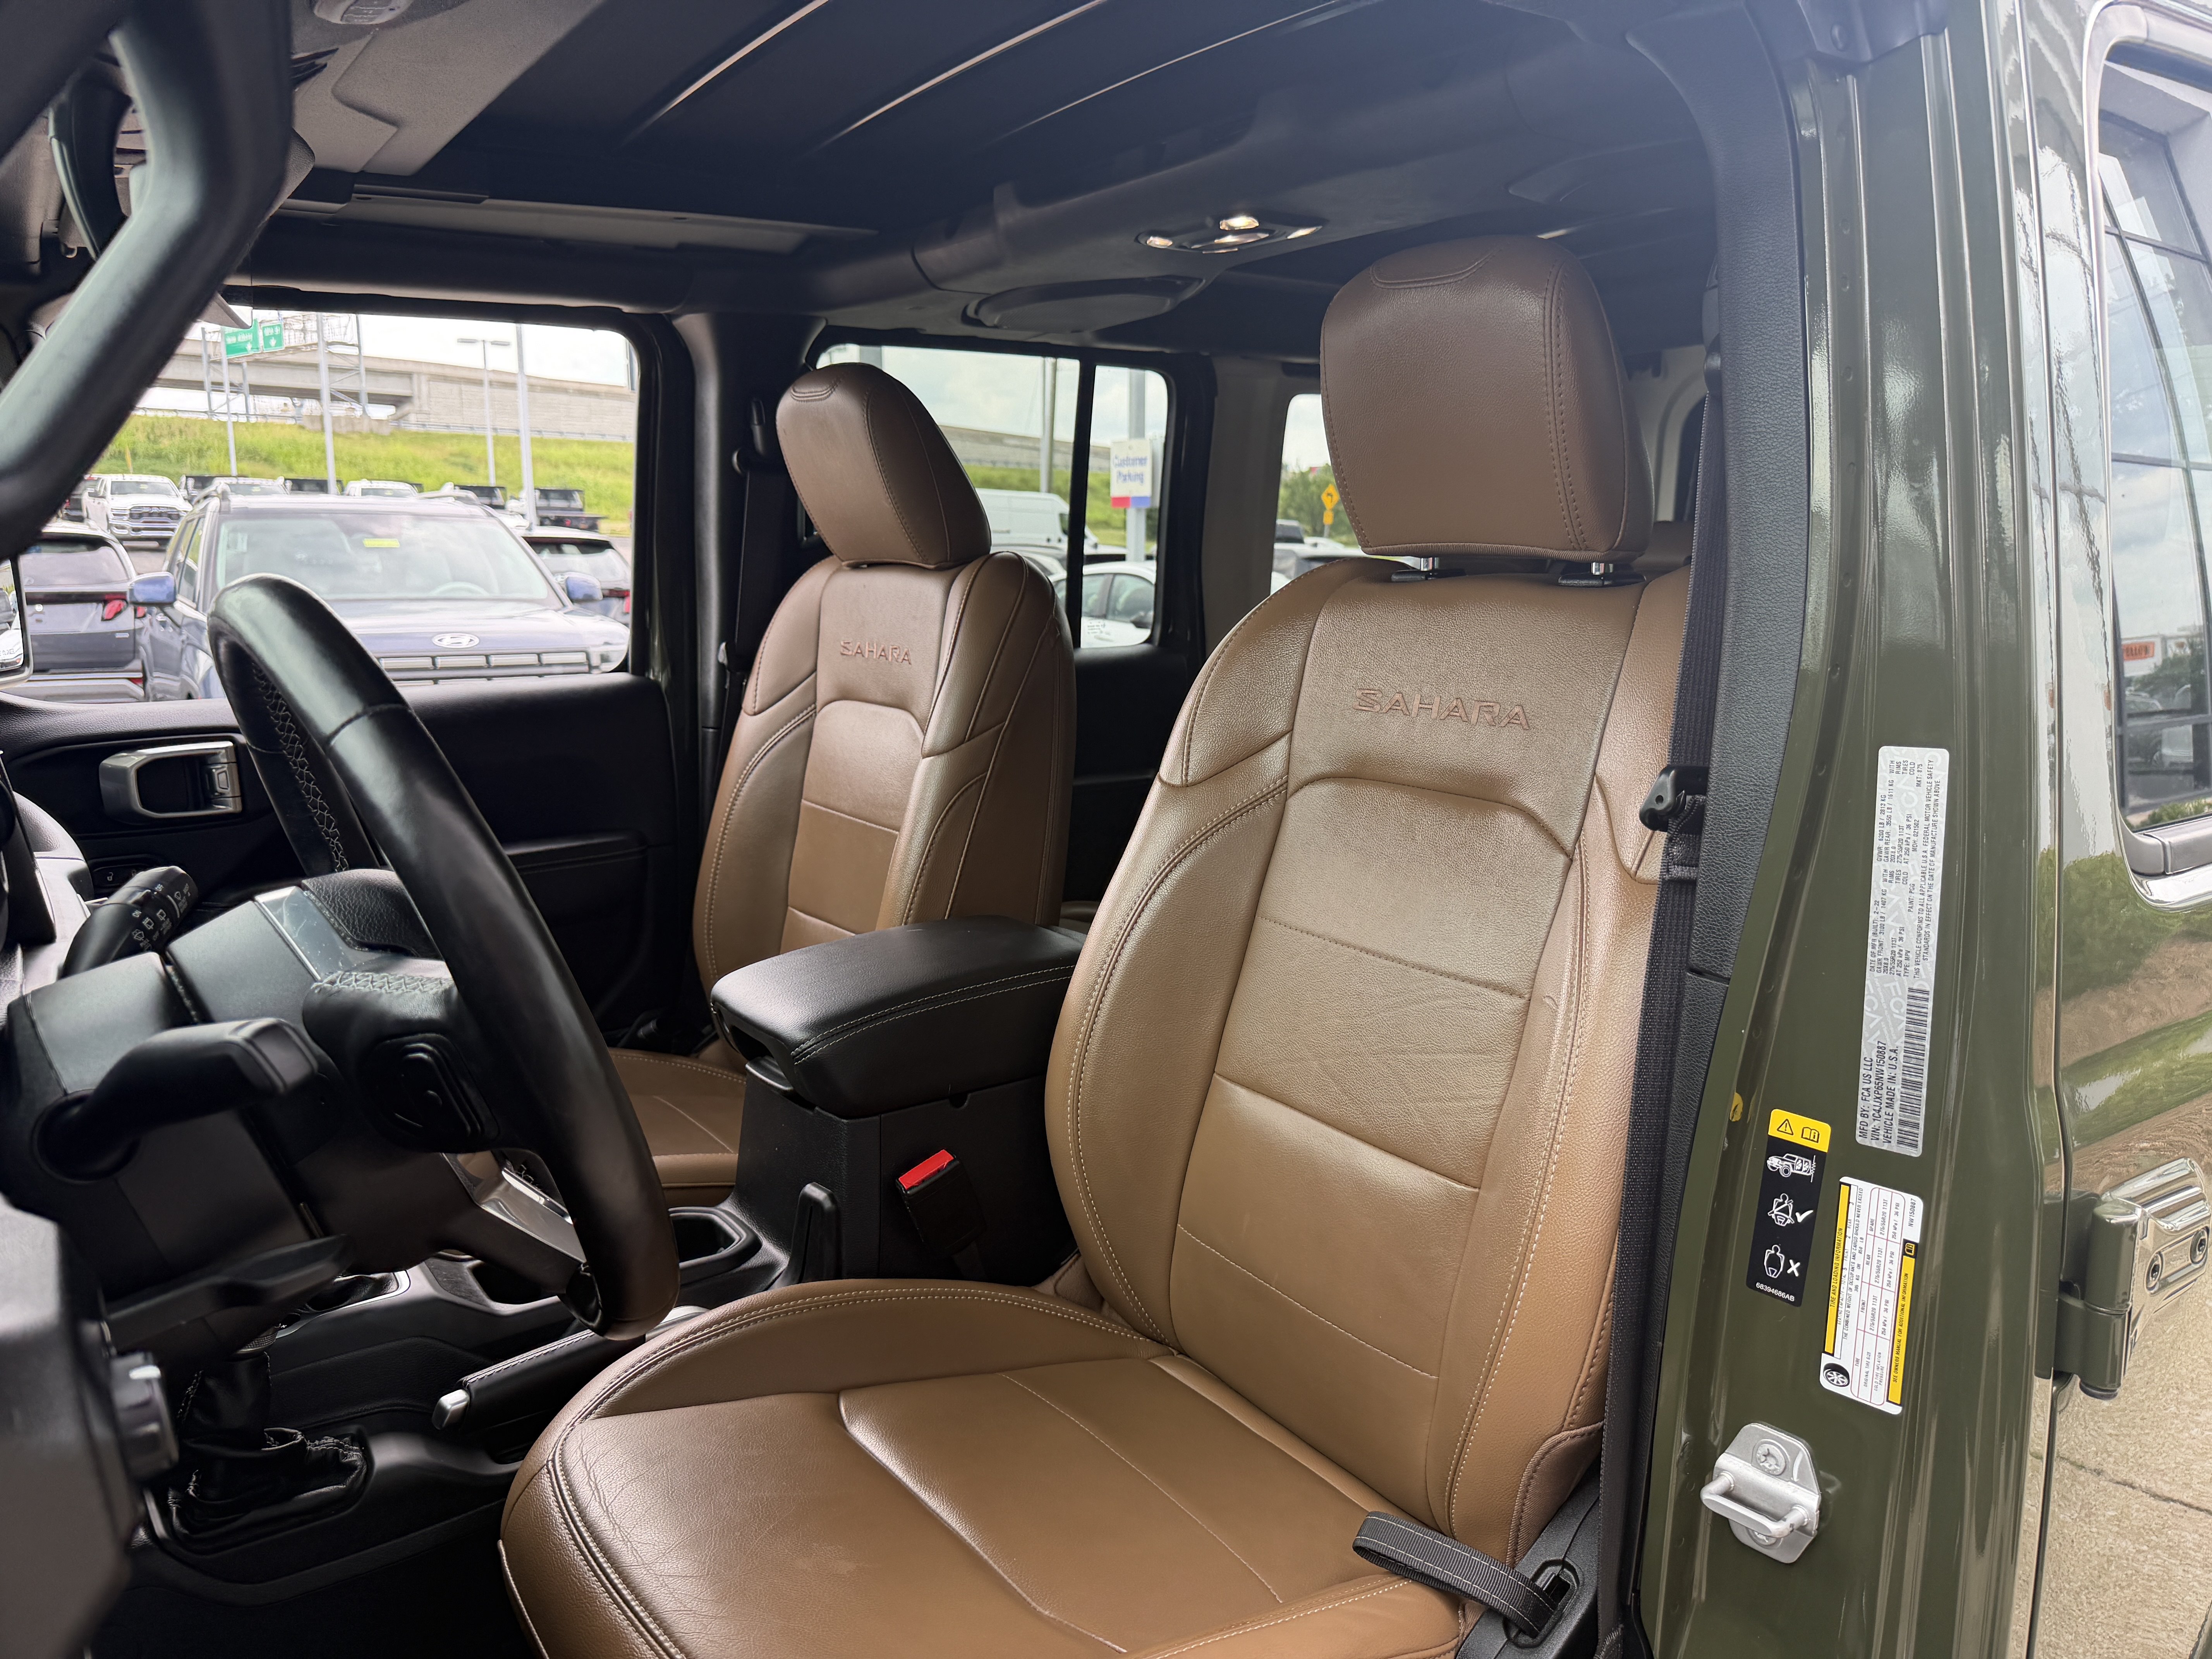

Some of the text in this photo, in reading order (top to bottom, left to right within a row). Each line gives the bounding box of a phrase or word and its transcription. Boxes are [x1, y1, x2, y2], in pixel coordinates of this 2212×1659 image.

[840, 641, 912, 665] SAHARA
[1353, 689, 1530, 730] SAHARA
[1858, 1057, 1873, 1138] MFD BY: FCA US LLC
[1870, 1041, 1886, 1140] VIN: 1C4JJXP65NW150887
[1882, 1046, 1898, 1143] VEHICLE MADE IN: U.S.A.
[1756, 1282, 1795, 1302] 68394686AB
